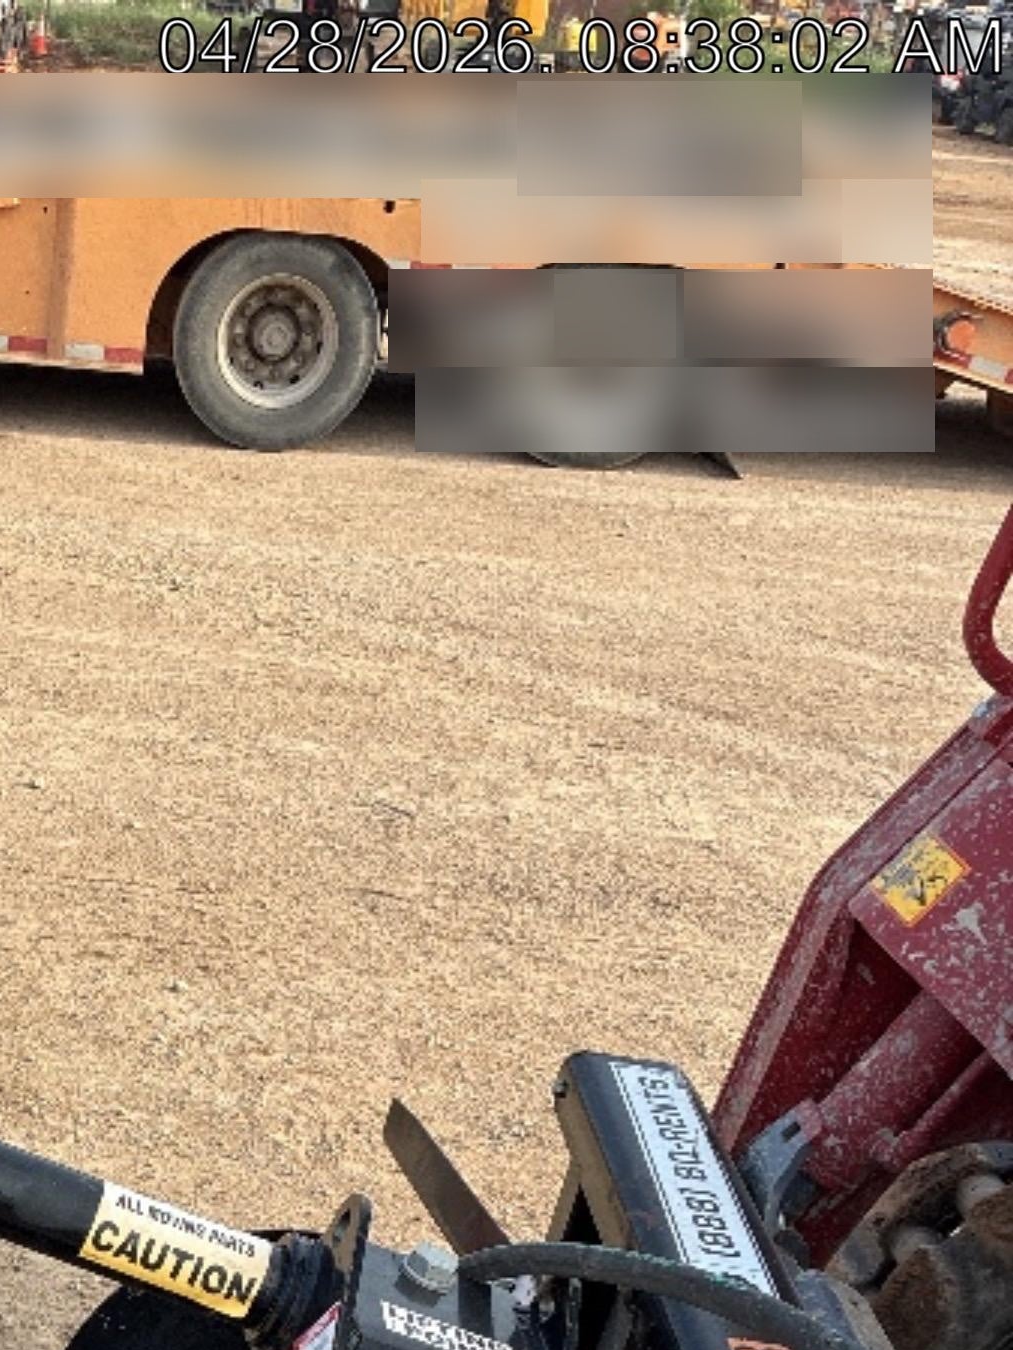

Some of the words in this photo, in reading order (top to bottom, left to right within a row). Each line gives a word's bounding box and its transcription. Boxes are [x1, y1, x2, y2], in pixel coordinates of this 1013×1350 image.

[115, 1194, 144, 1216] ALL
[208, 1229, 256, 1258] PARTS
[677, 1187, 741, 1259] (888)
[91, 1220, 257, 1306] CAUTION
